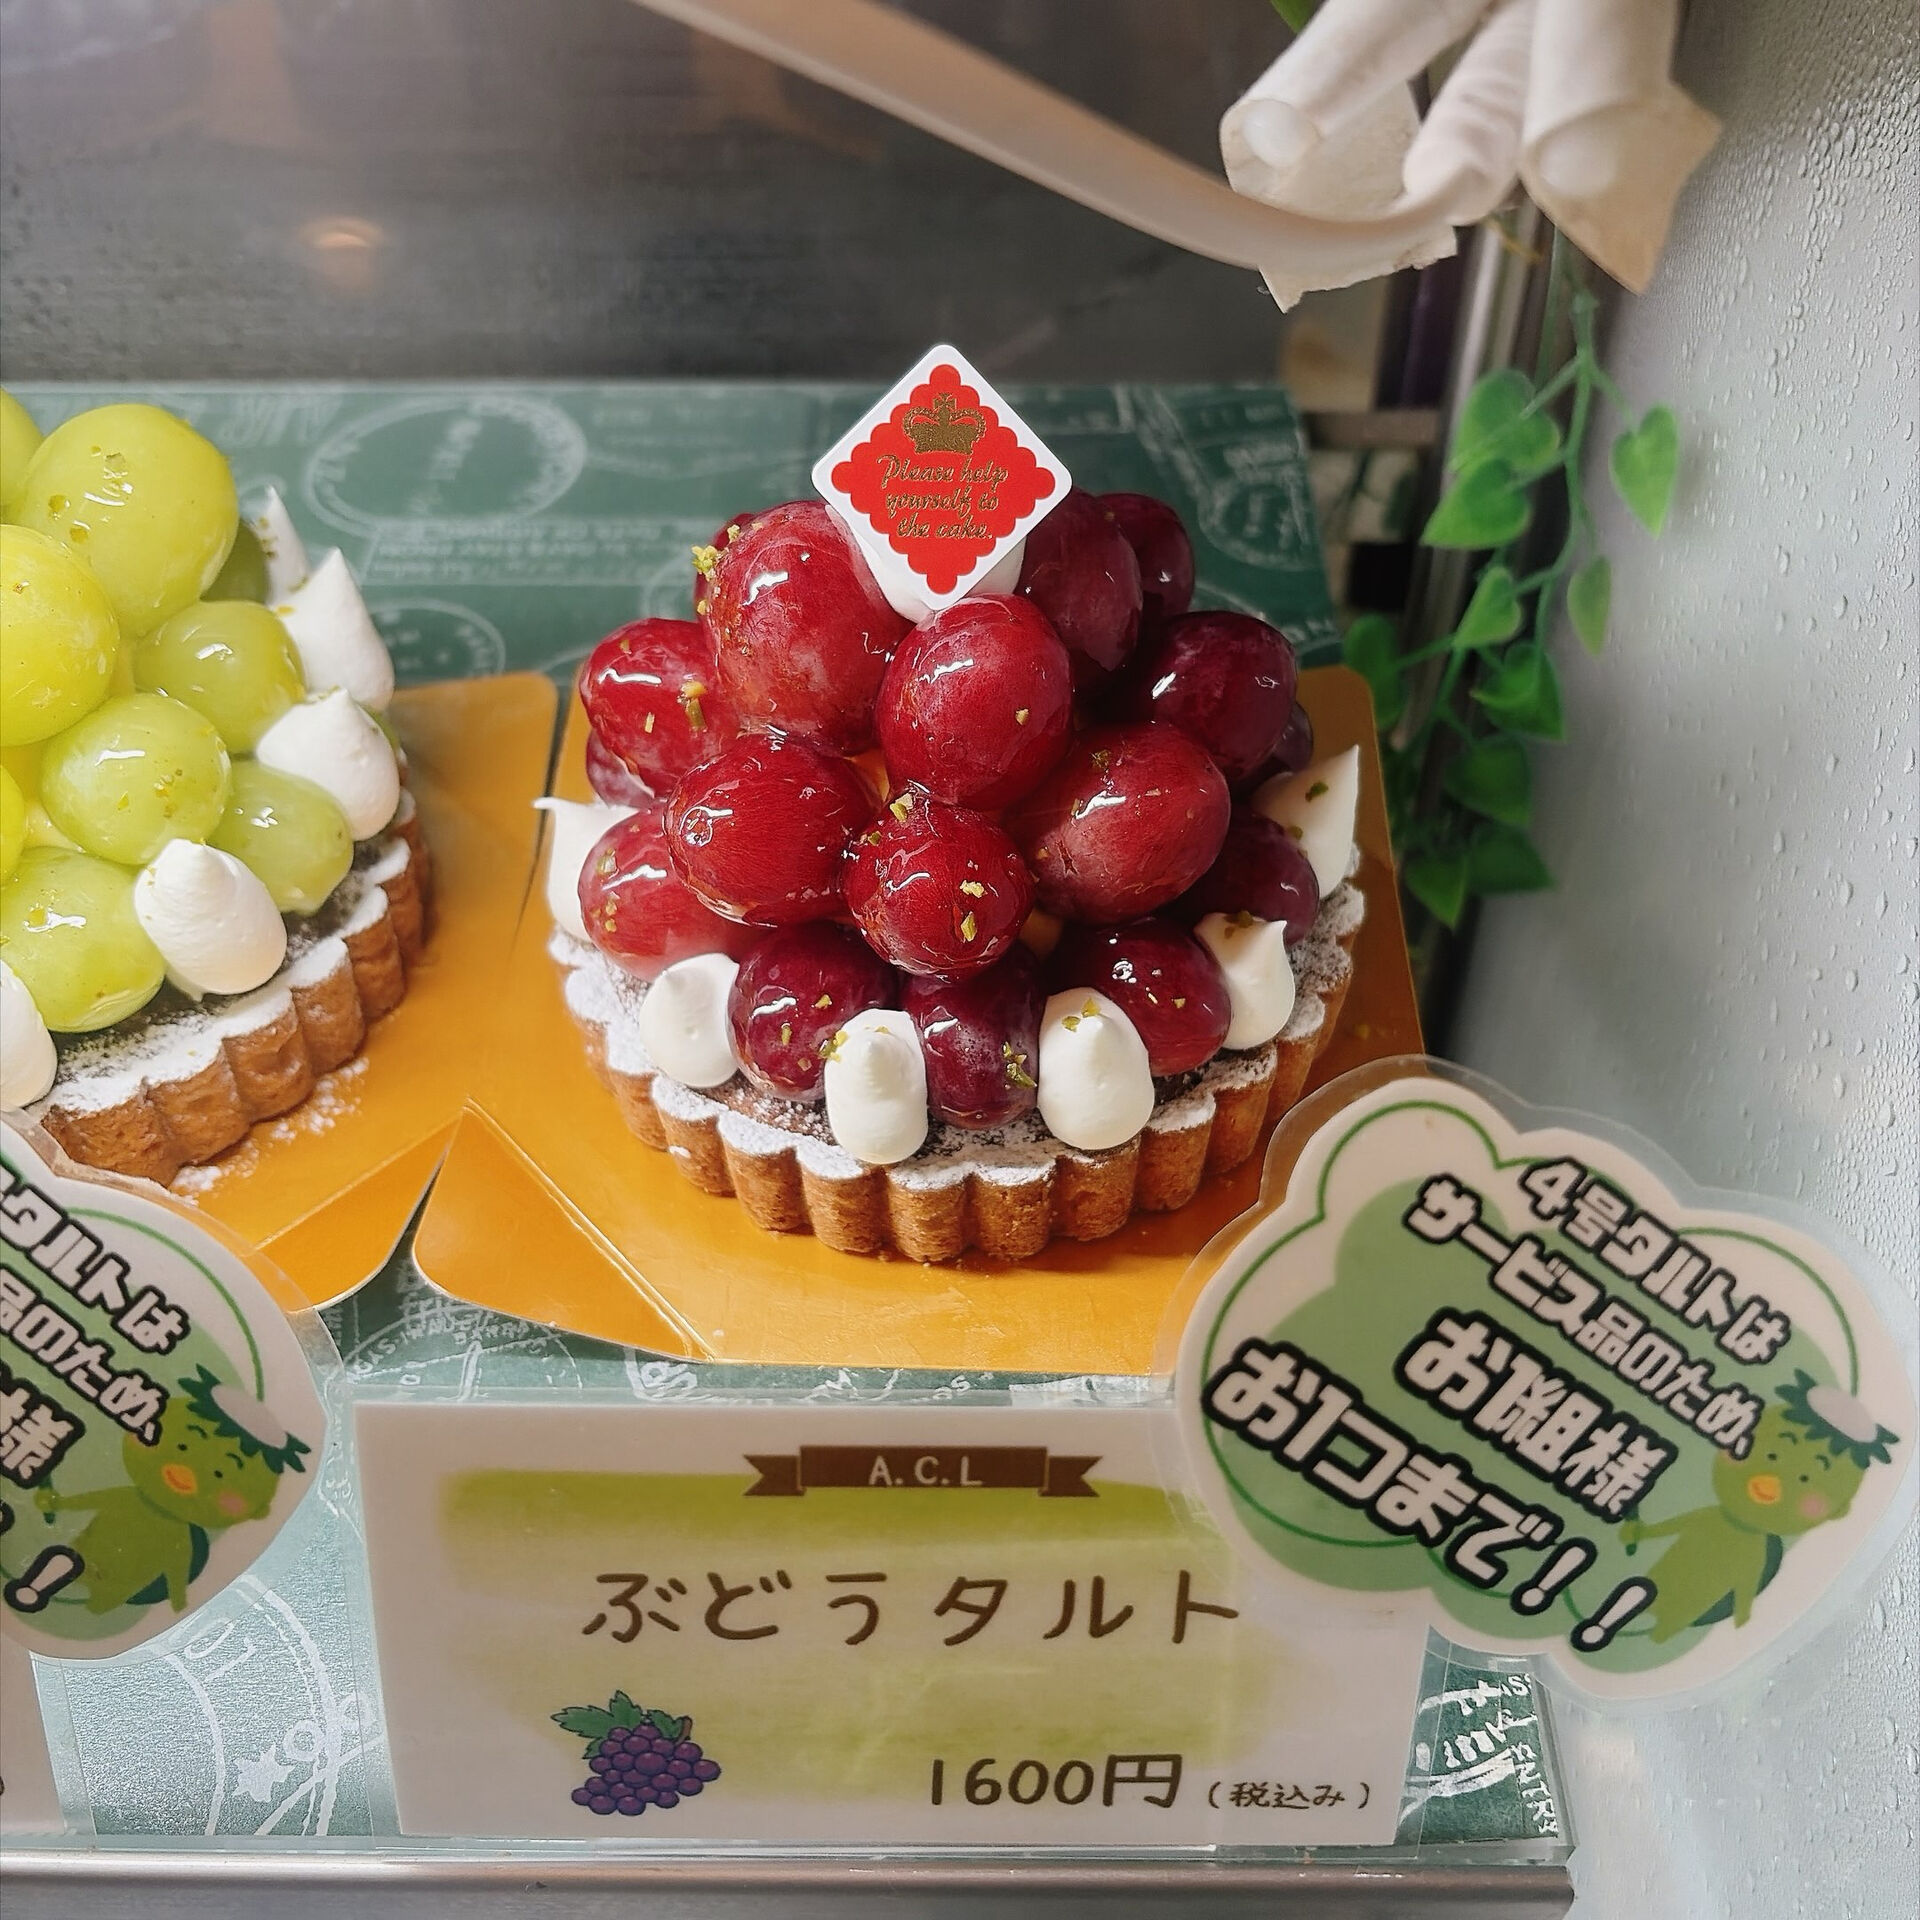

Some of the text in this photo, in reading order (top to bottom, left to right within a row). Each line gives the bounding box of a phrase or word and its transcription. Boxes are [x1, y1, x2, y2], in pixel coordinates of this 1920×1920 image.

[877, 455, 1009, 493] Please help
[886, 487, 999, 518] yourself to
[897, 514, 993, 539] the cake.
[0, 1166, 187, 1352] タルトは
[1521, 1159, 1789, 1362] 4号タルトは
[1404, 1176, 1763, 1457] サービス品のため、
[868, 1455, 984, 1487] A.C.L
[582, 1570, 1240, 1645] ぶどうタルト
[931, 1753, 1372, 1809] 1600円 (税込み)
